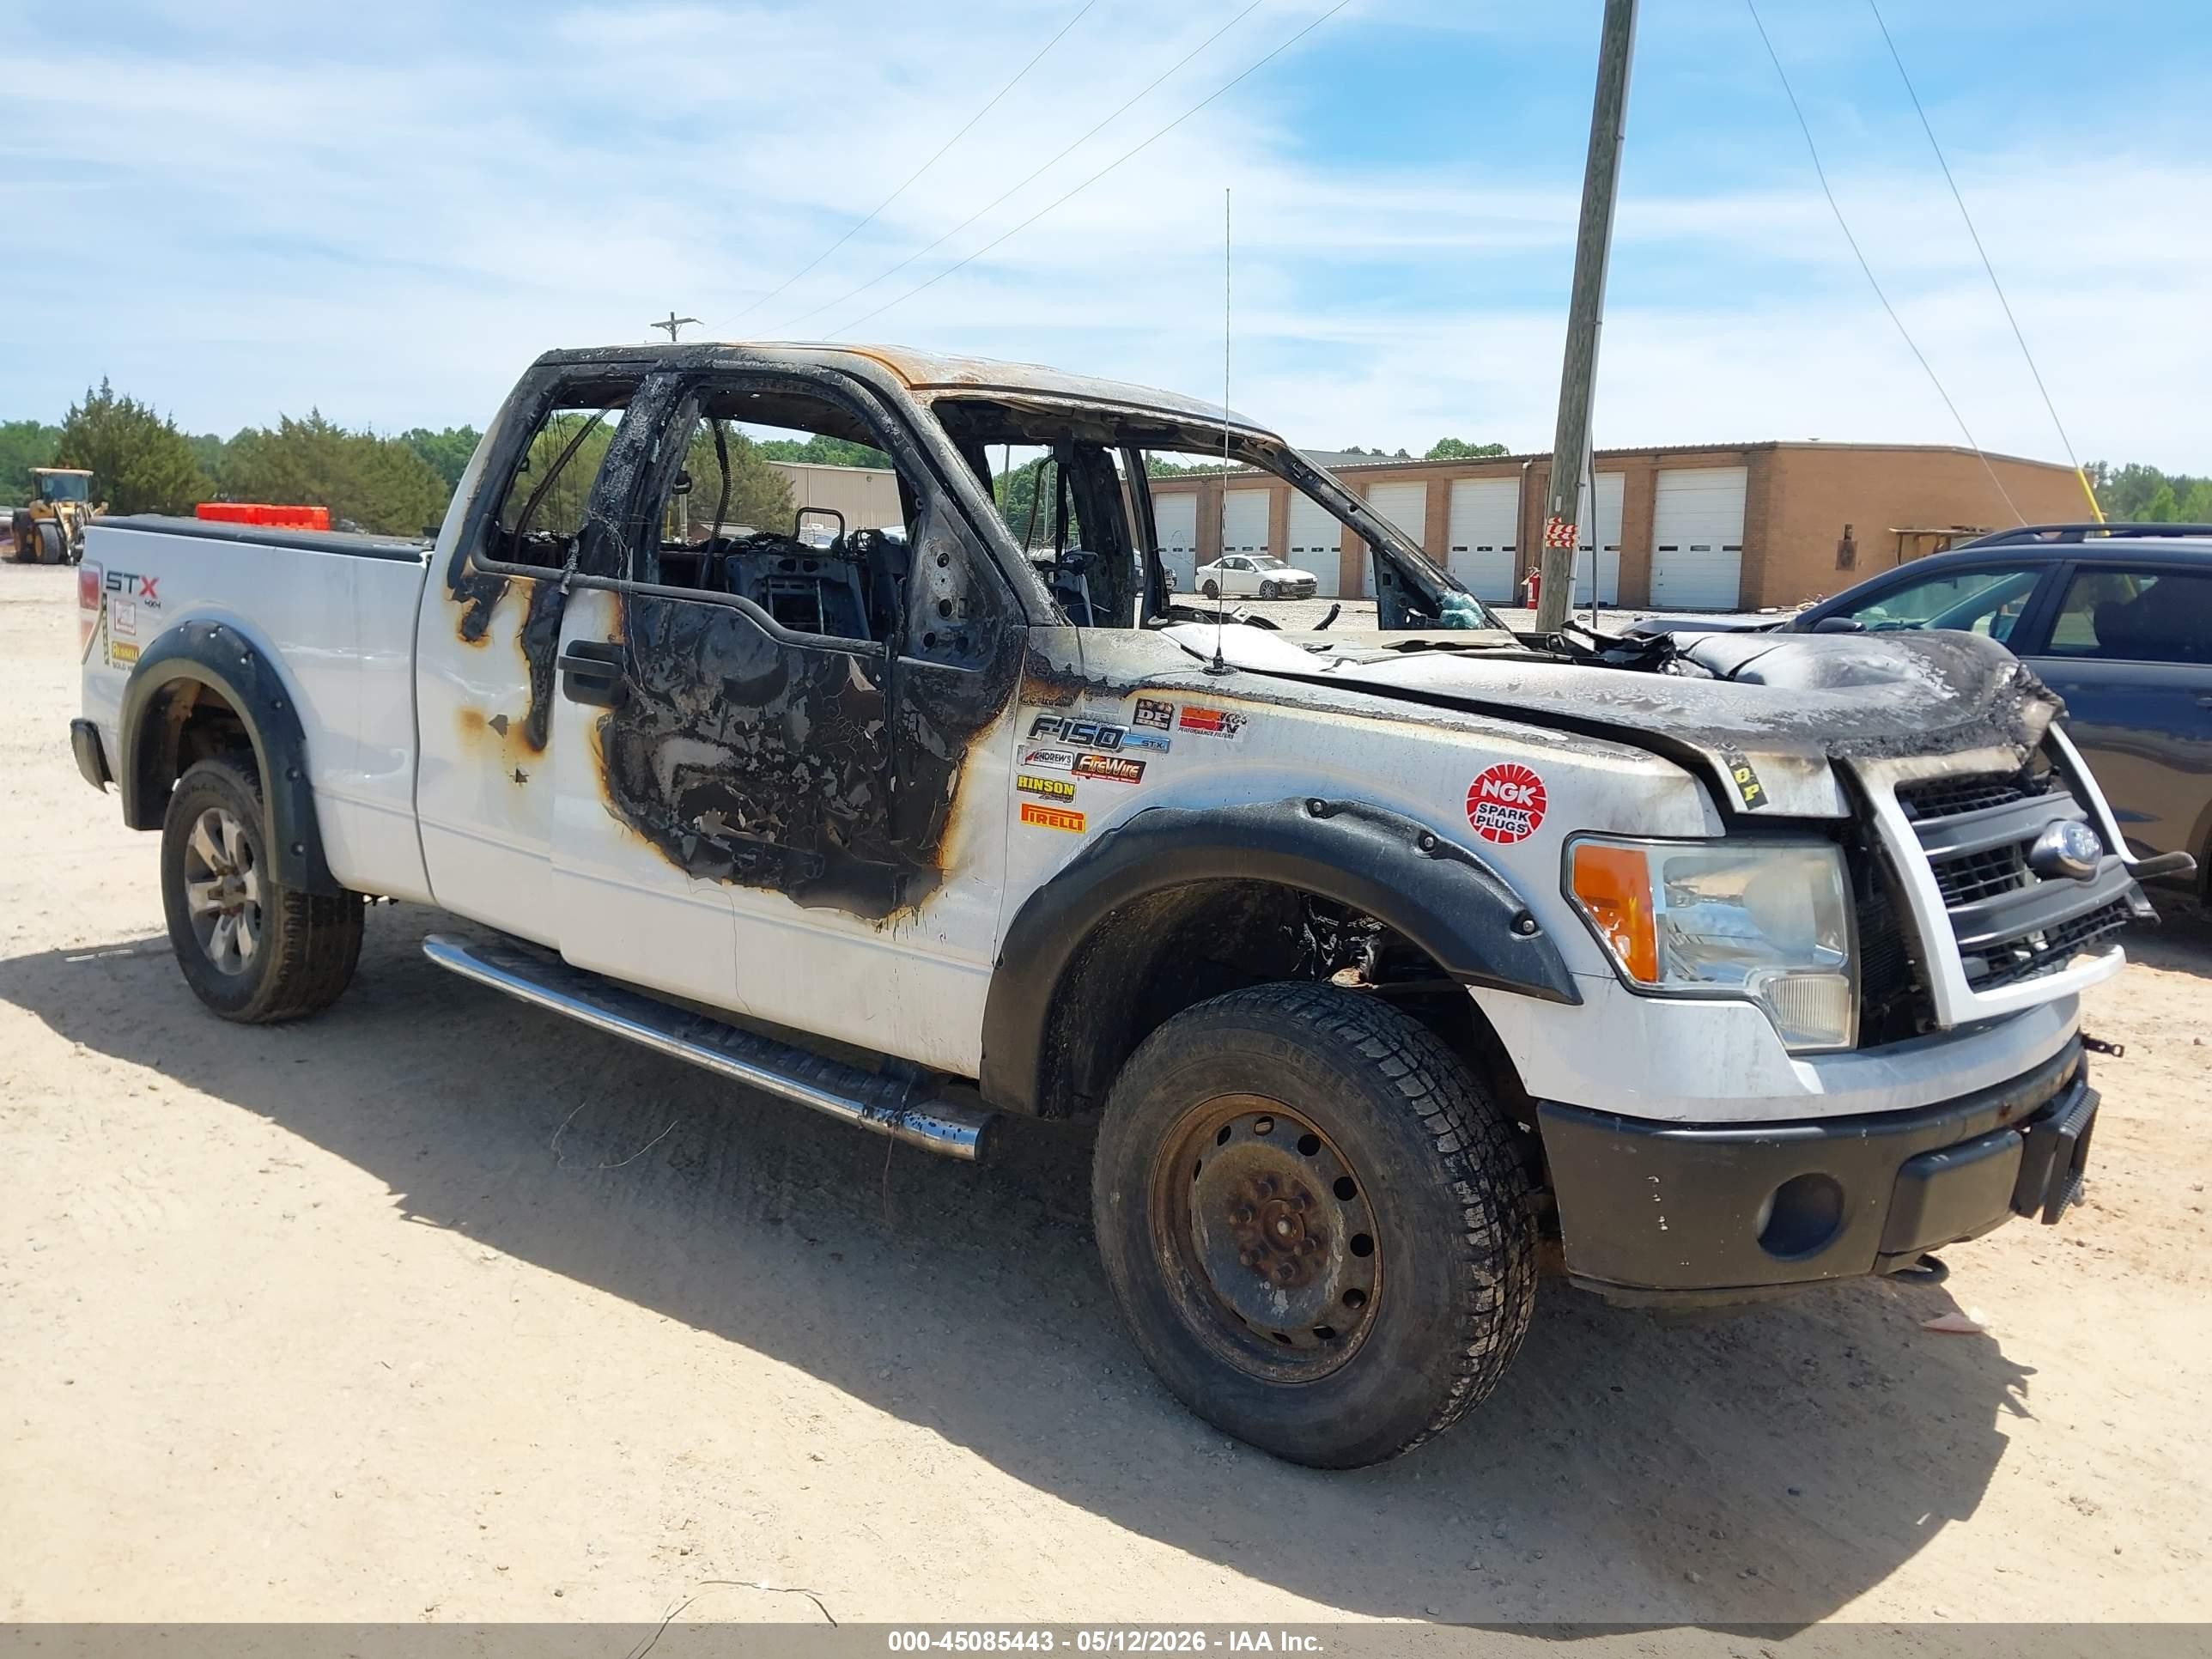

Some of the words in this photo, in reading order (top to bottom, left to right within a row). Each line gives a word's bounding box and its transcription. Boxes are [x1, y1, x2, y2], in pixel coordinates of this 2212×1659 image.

[106, 570, 160, 599] STX
[1138, 708, 1170, 723] DP
[1026, 714, 1130, 752] F-150
[1177, 727, 1214, 737] PERFORMANCE
[1141, 739, 1164, 748] STX
[1033, 751, 1073, 764] ANDREWS
[1018, 775, 1074, 796] HINSON
[1480, 777, 1537, 807] NGK
[1021, 803, 1085, 831] PIRELLI
[1478, 803, 1529, 823] SPARK
[1475, 815, 1527, 834] PLUGS
